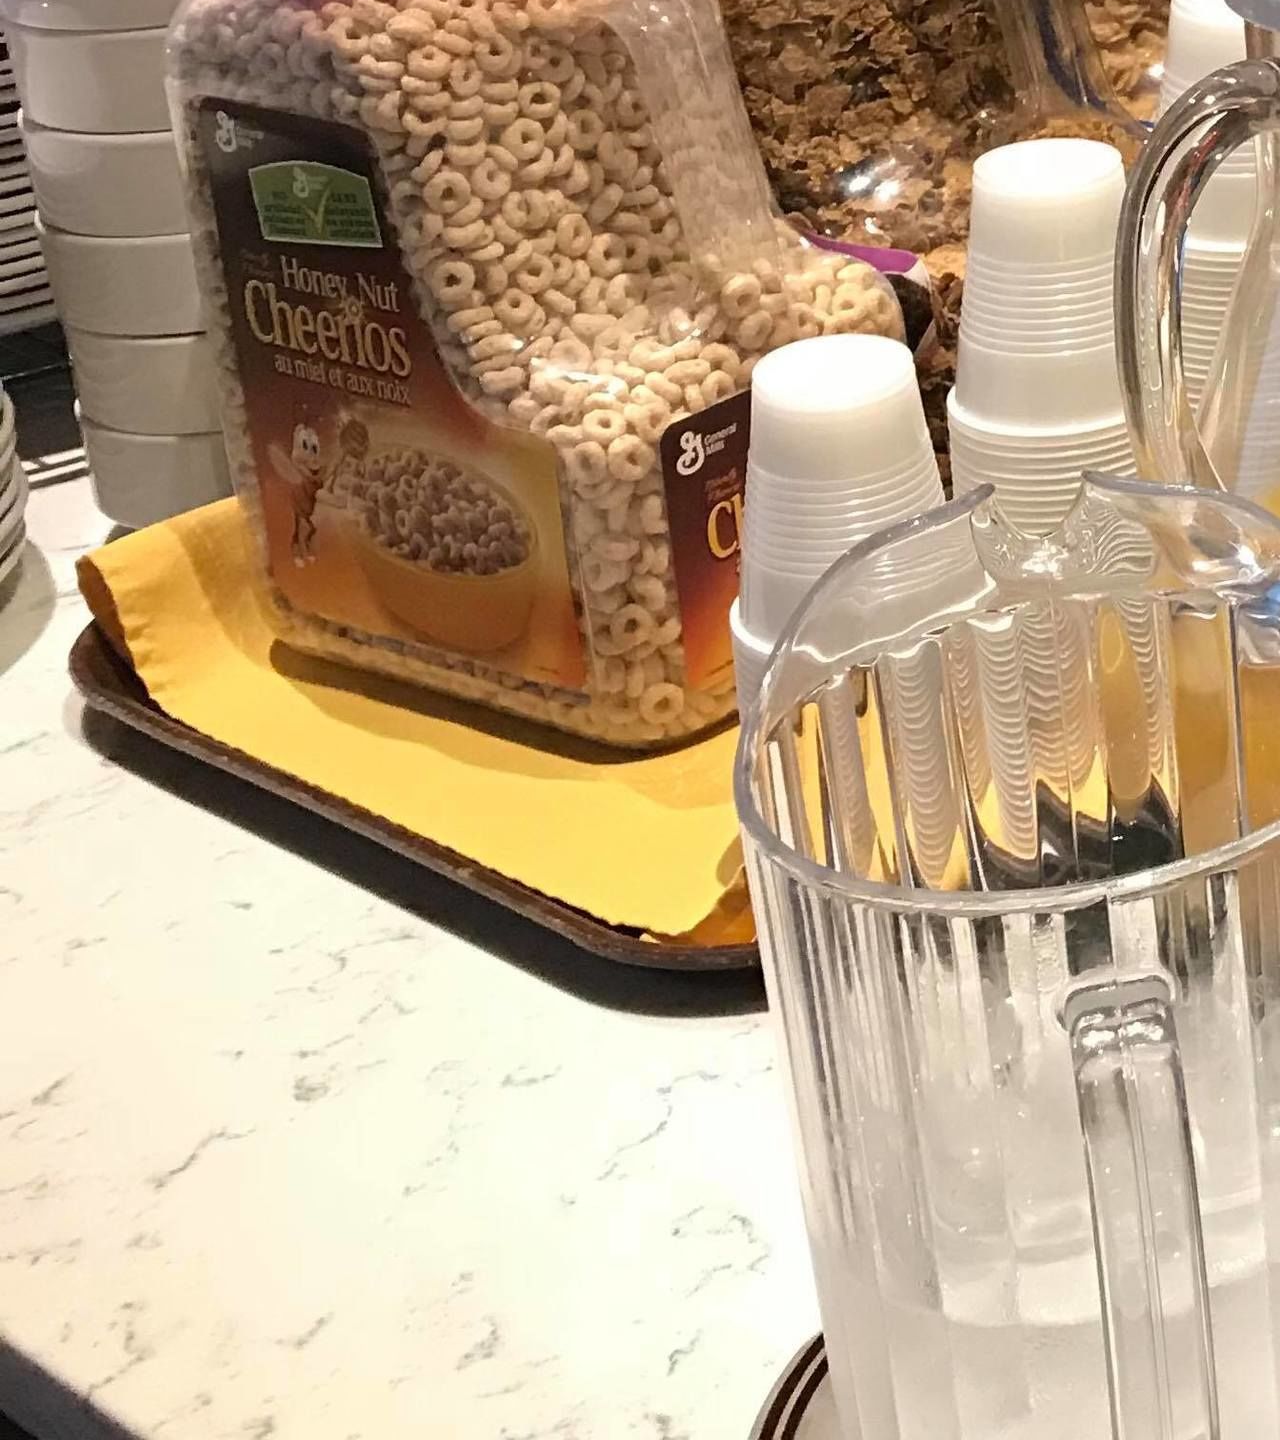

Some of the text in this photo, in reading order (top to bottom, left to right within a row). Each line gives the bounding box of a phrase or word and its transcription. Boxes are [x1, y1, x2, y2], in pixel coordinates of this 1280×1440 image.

[280, 254, 348, 304] Honey
[356, 271, 401, 313] Nut
[243, 279, 412, 378] Cheerios
[274, 353, 412, 407] au miel et aux noix
